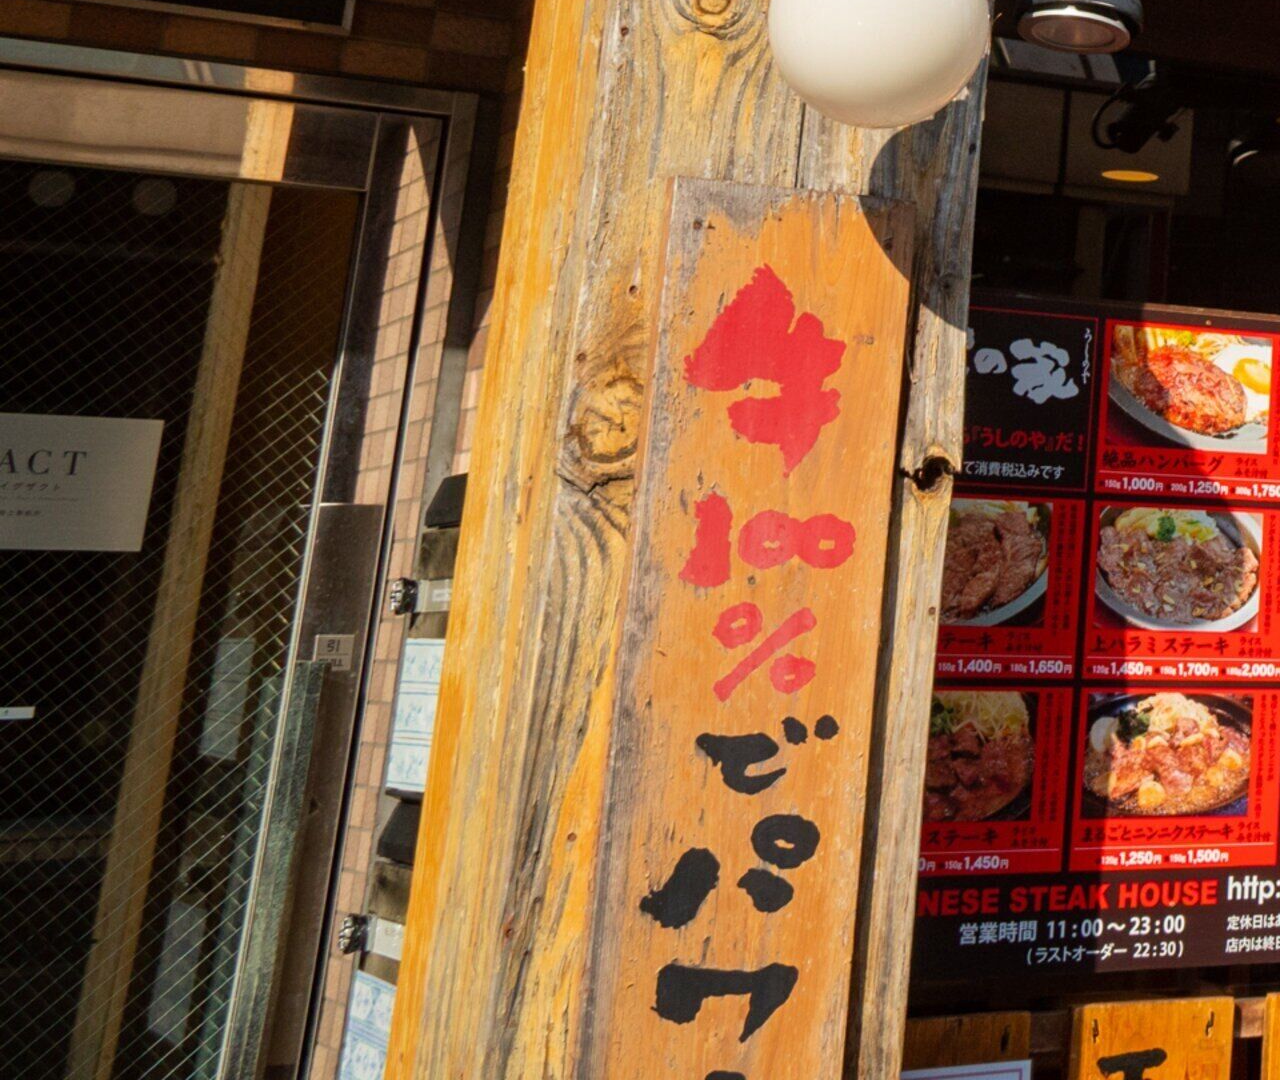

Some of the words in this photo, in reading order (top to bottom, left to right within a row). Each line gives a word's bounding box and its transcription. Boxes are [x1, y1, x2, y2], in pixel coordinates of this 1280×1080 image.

[964, 460, 1066, 480] て消費税込みです
[1103, 449, 1224, 474] 絶品ハンバーグ
[1082, 823, 1234, 843] まるごとニンニクステーキ
[1009, 883, 1110, 914] STEAK
[1117, 879, 1219, 910] HOUSE
[959, 920, 1037, 946] 営業時間
